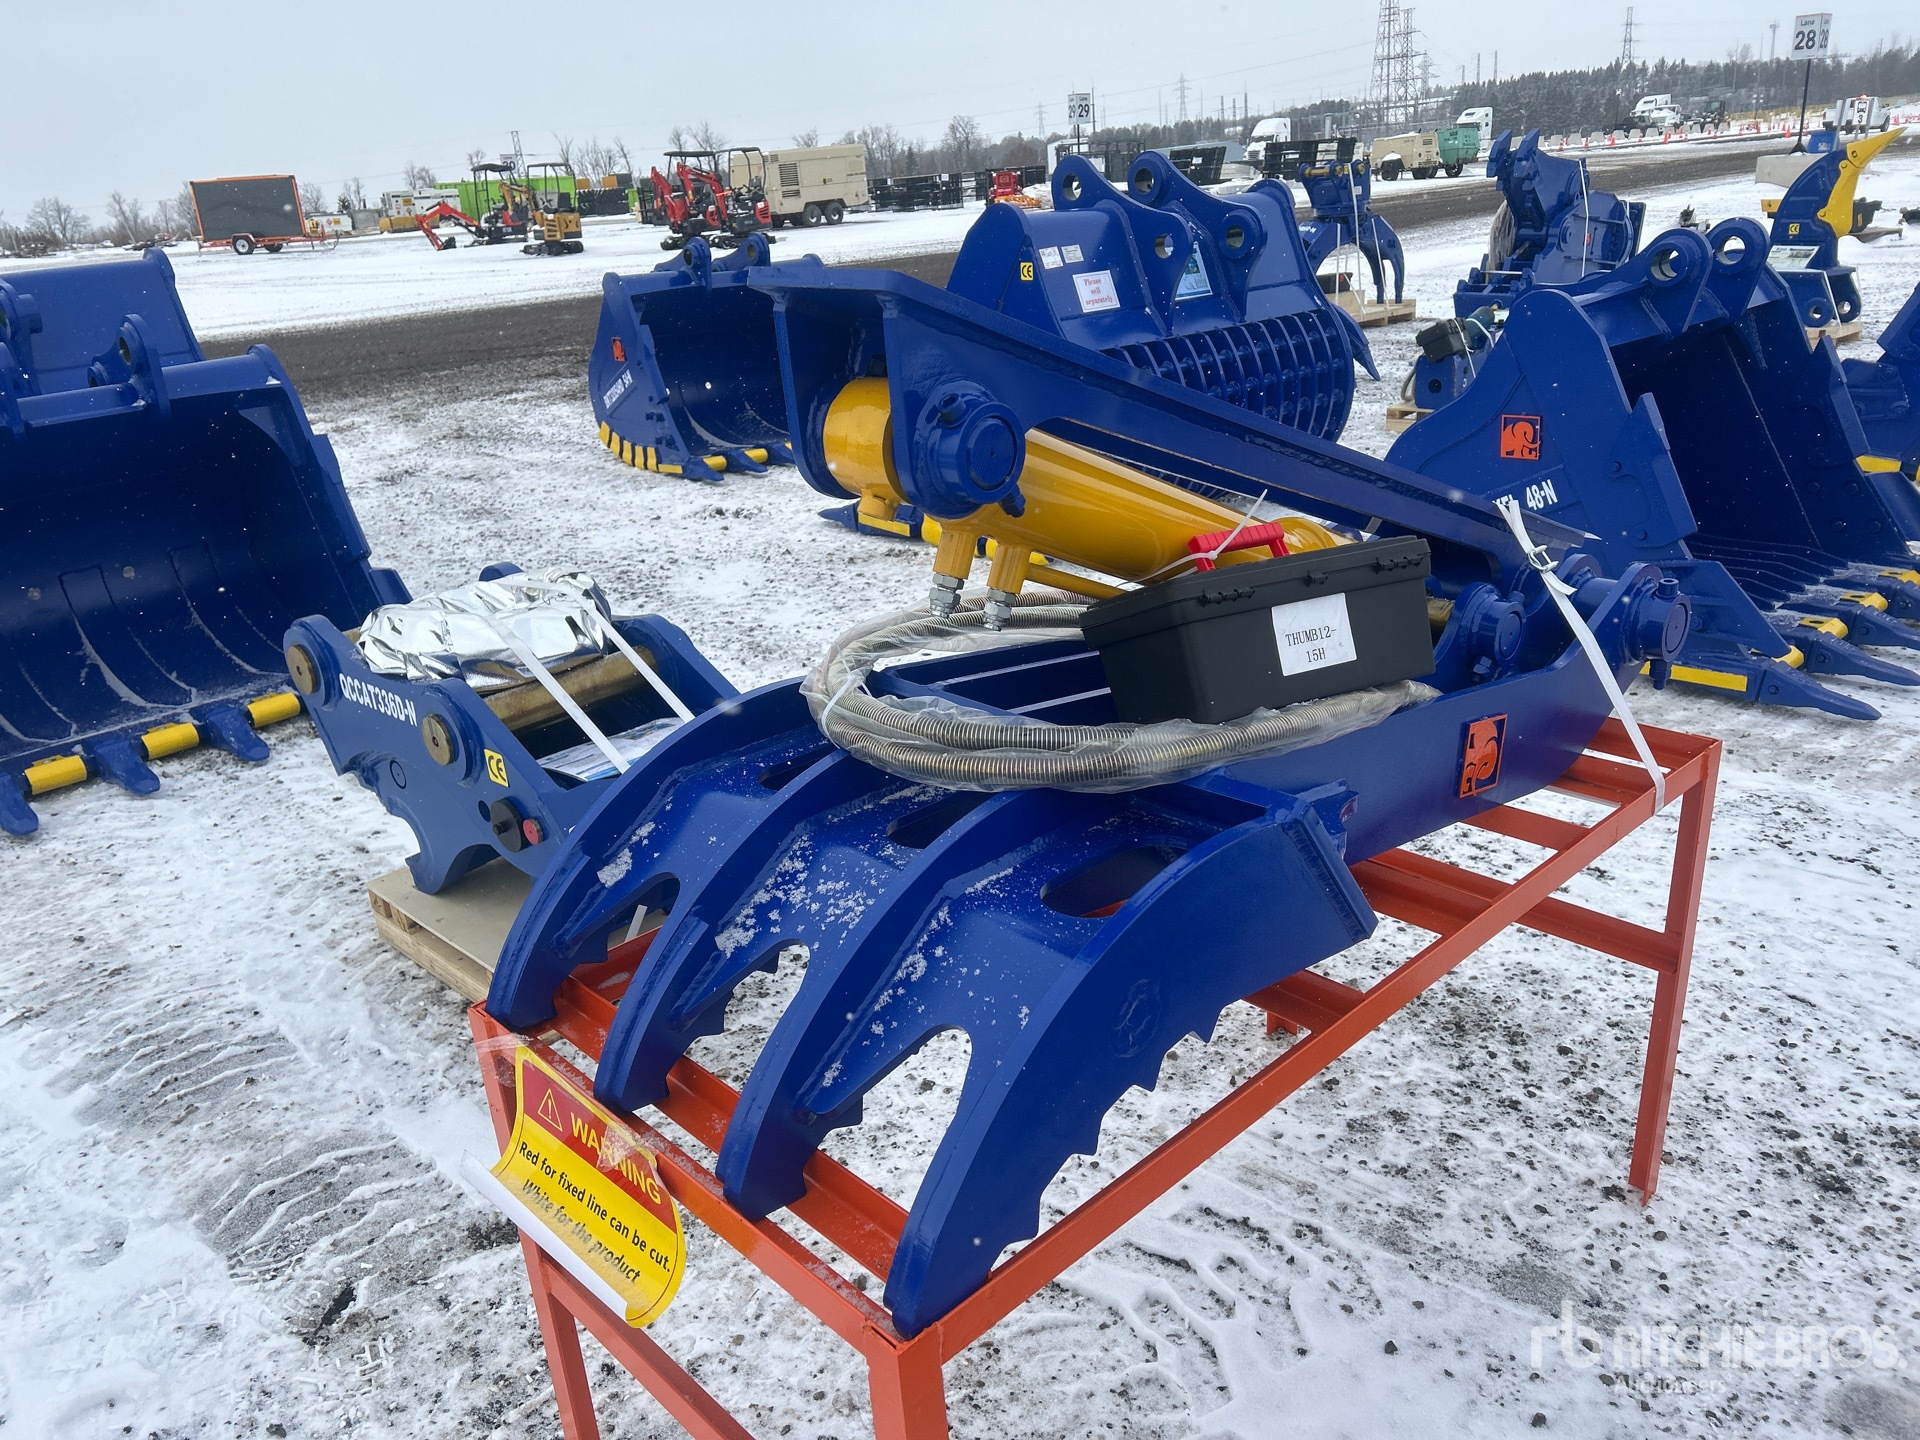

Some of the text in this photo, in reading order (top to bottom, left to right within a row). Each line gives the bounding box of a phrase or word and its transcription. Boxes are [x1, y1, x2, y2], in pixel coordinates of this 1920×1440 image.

[1794, 29, 1817, 50] 28
[1820, 29, 1829, 48] 28
[1078, 103, 1090, 118] 29
[1857, 114, 1864, 123] 3
[1021, 264, 1033, 278] CE
[1084, 278, 1102, 286] Please
[1085, 295, 1113, 306] separately
[1526, 479, 1558, 511] 48-N
[1285, 625, 1337, 647] THUMB12-
[1306, 647, 1327, 663] 15H
[338, 672, 418, 727] QCCAT336D-N
[487, 755, 507, 783] CE
[570, 1111, 662, 1205] WARNING
[519, 1141, 670, 1273] Red for fixed line can be cut.
[522, 1178, 641, 1284] White for the product
